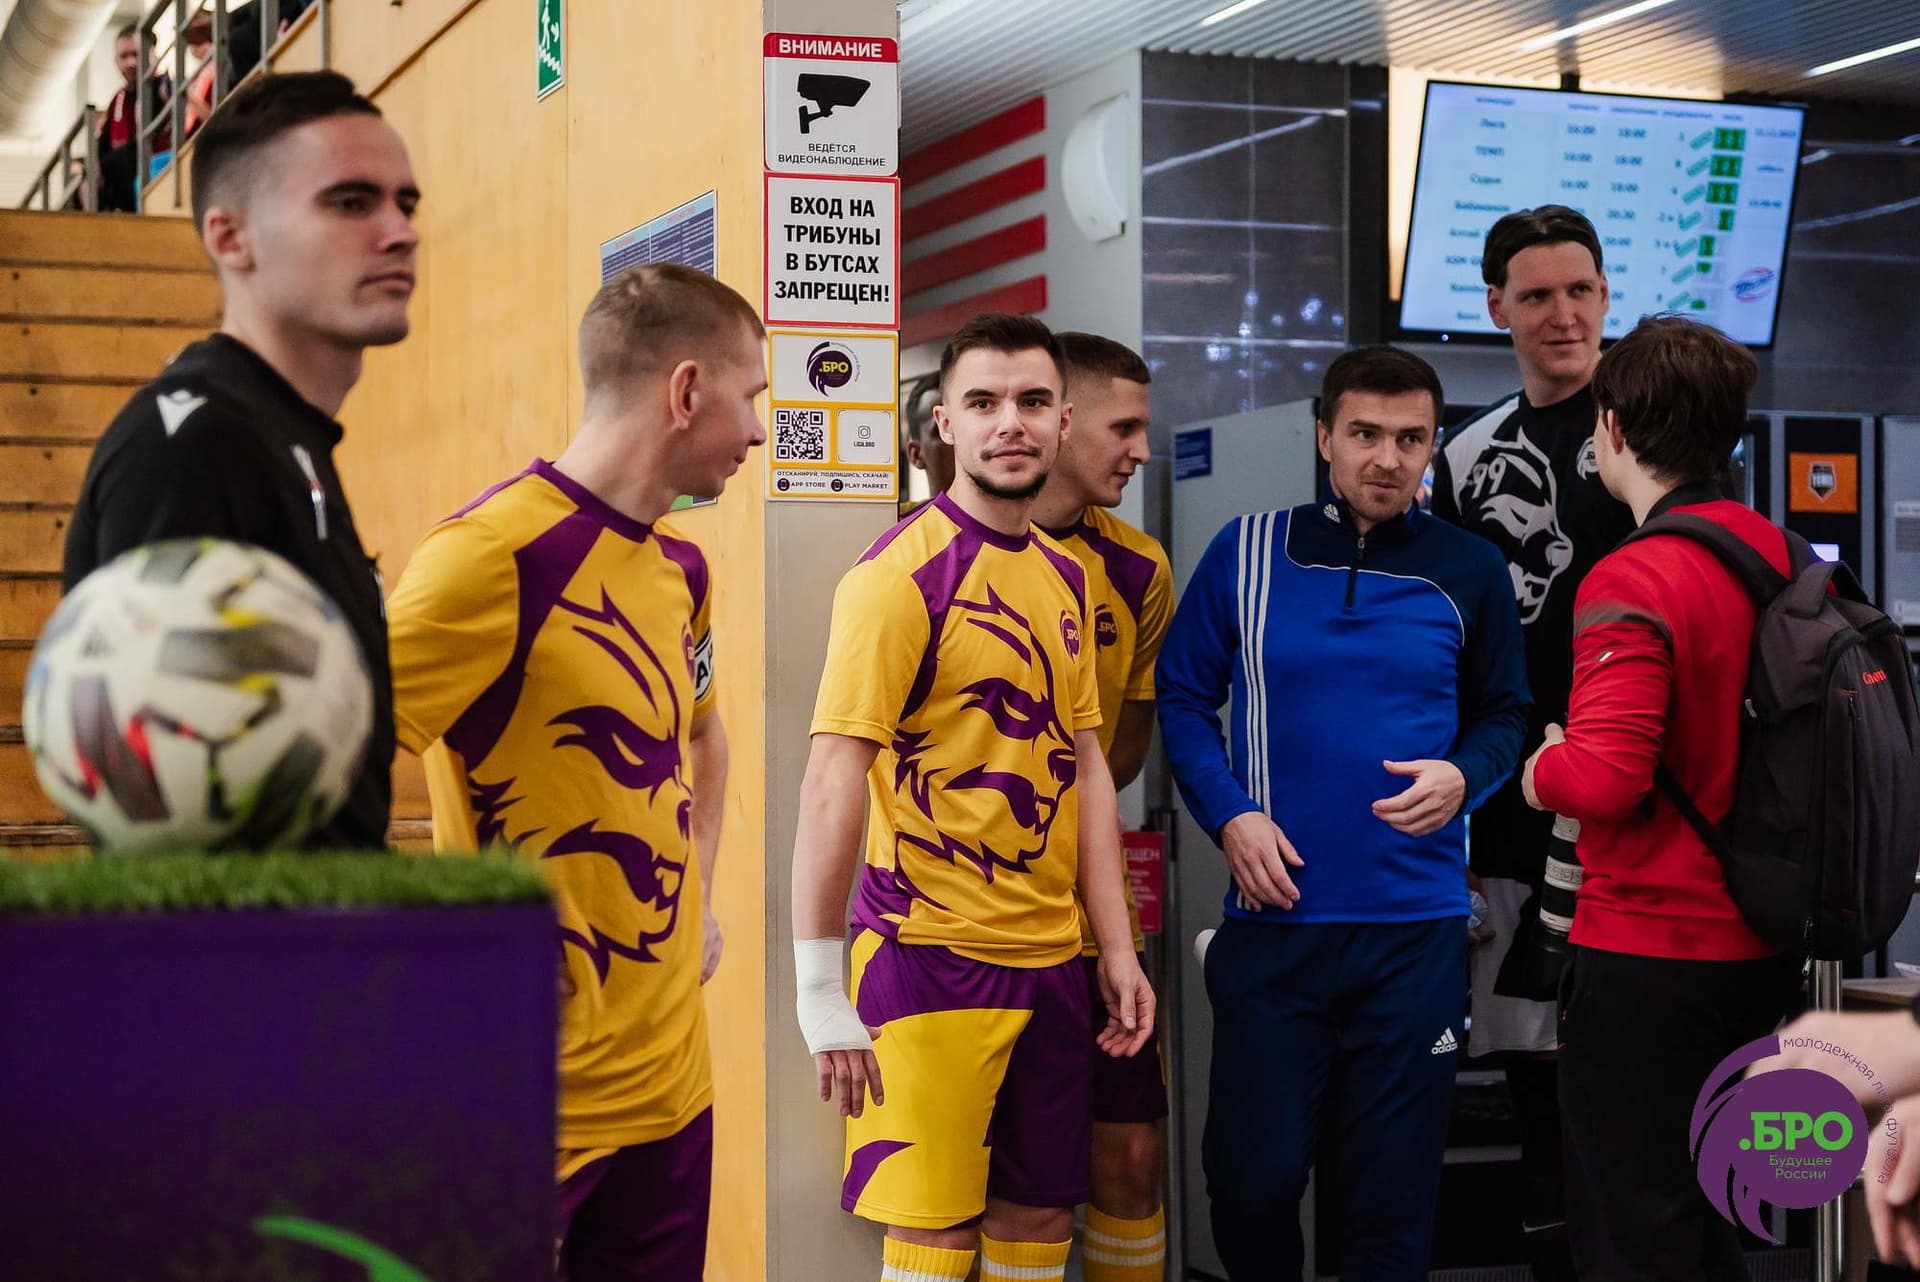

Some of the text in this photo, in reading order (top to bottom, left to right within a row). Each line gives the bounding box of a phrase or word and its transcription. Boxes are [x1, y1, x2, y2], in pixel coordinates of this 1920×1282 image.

[779, 39, 883, 58] ВНИМАНИЕ
[778, 154, 886, 167] ВИДЕОНАБЛЮДЕНИЕ
[790, 197, 875, 219] ВХОД НА
[784, 224, 881, 246] ТРИБУНЫ
[786, 253, 879, 274] В БУТСАХ
[775, 281, 890, 305] ЗАПРЕЩЕН!
[1472, 456, 1507, 499] 99
